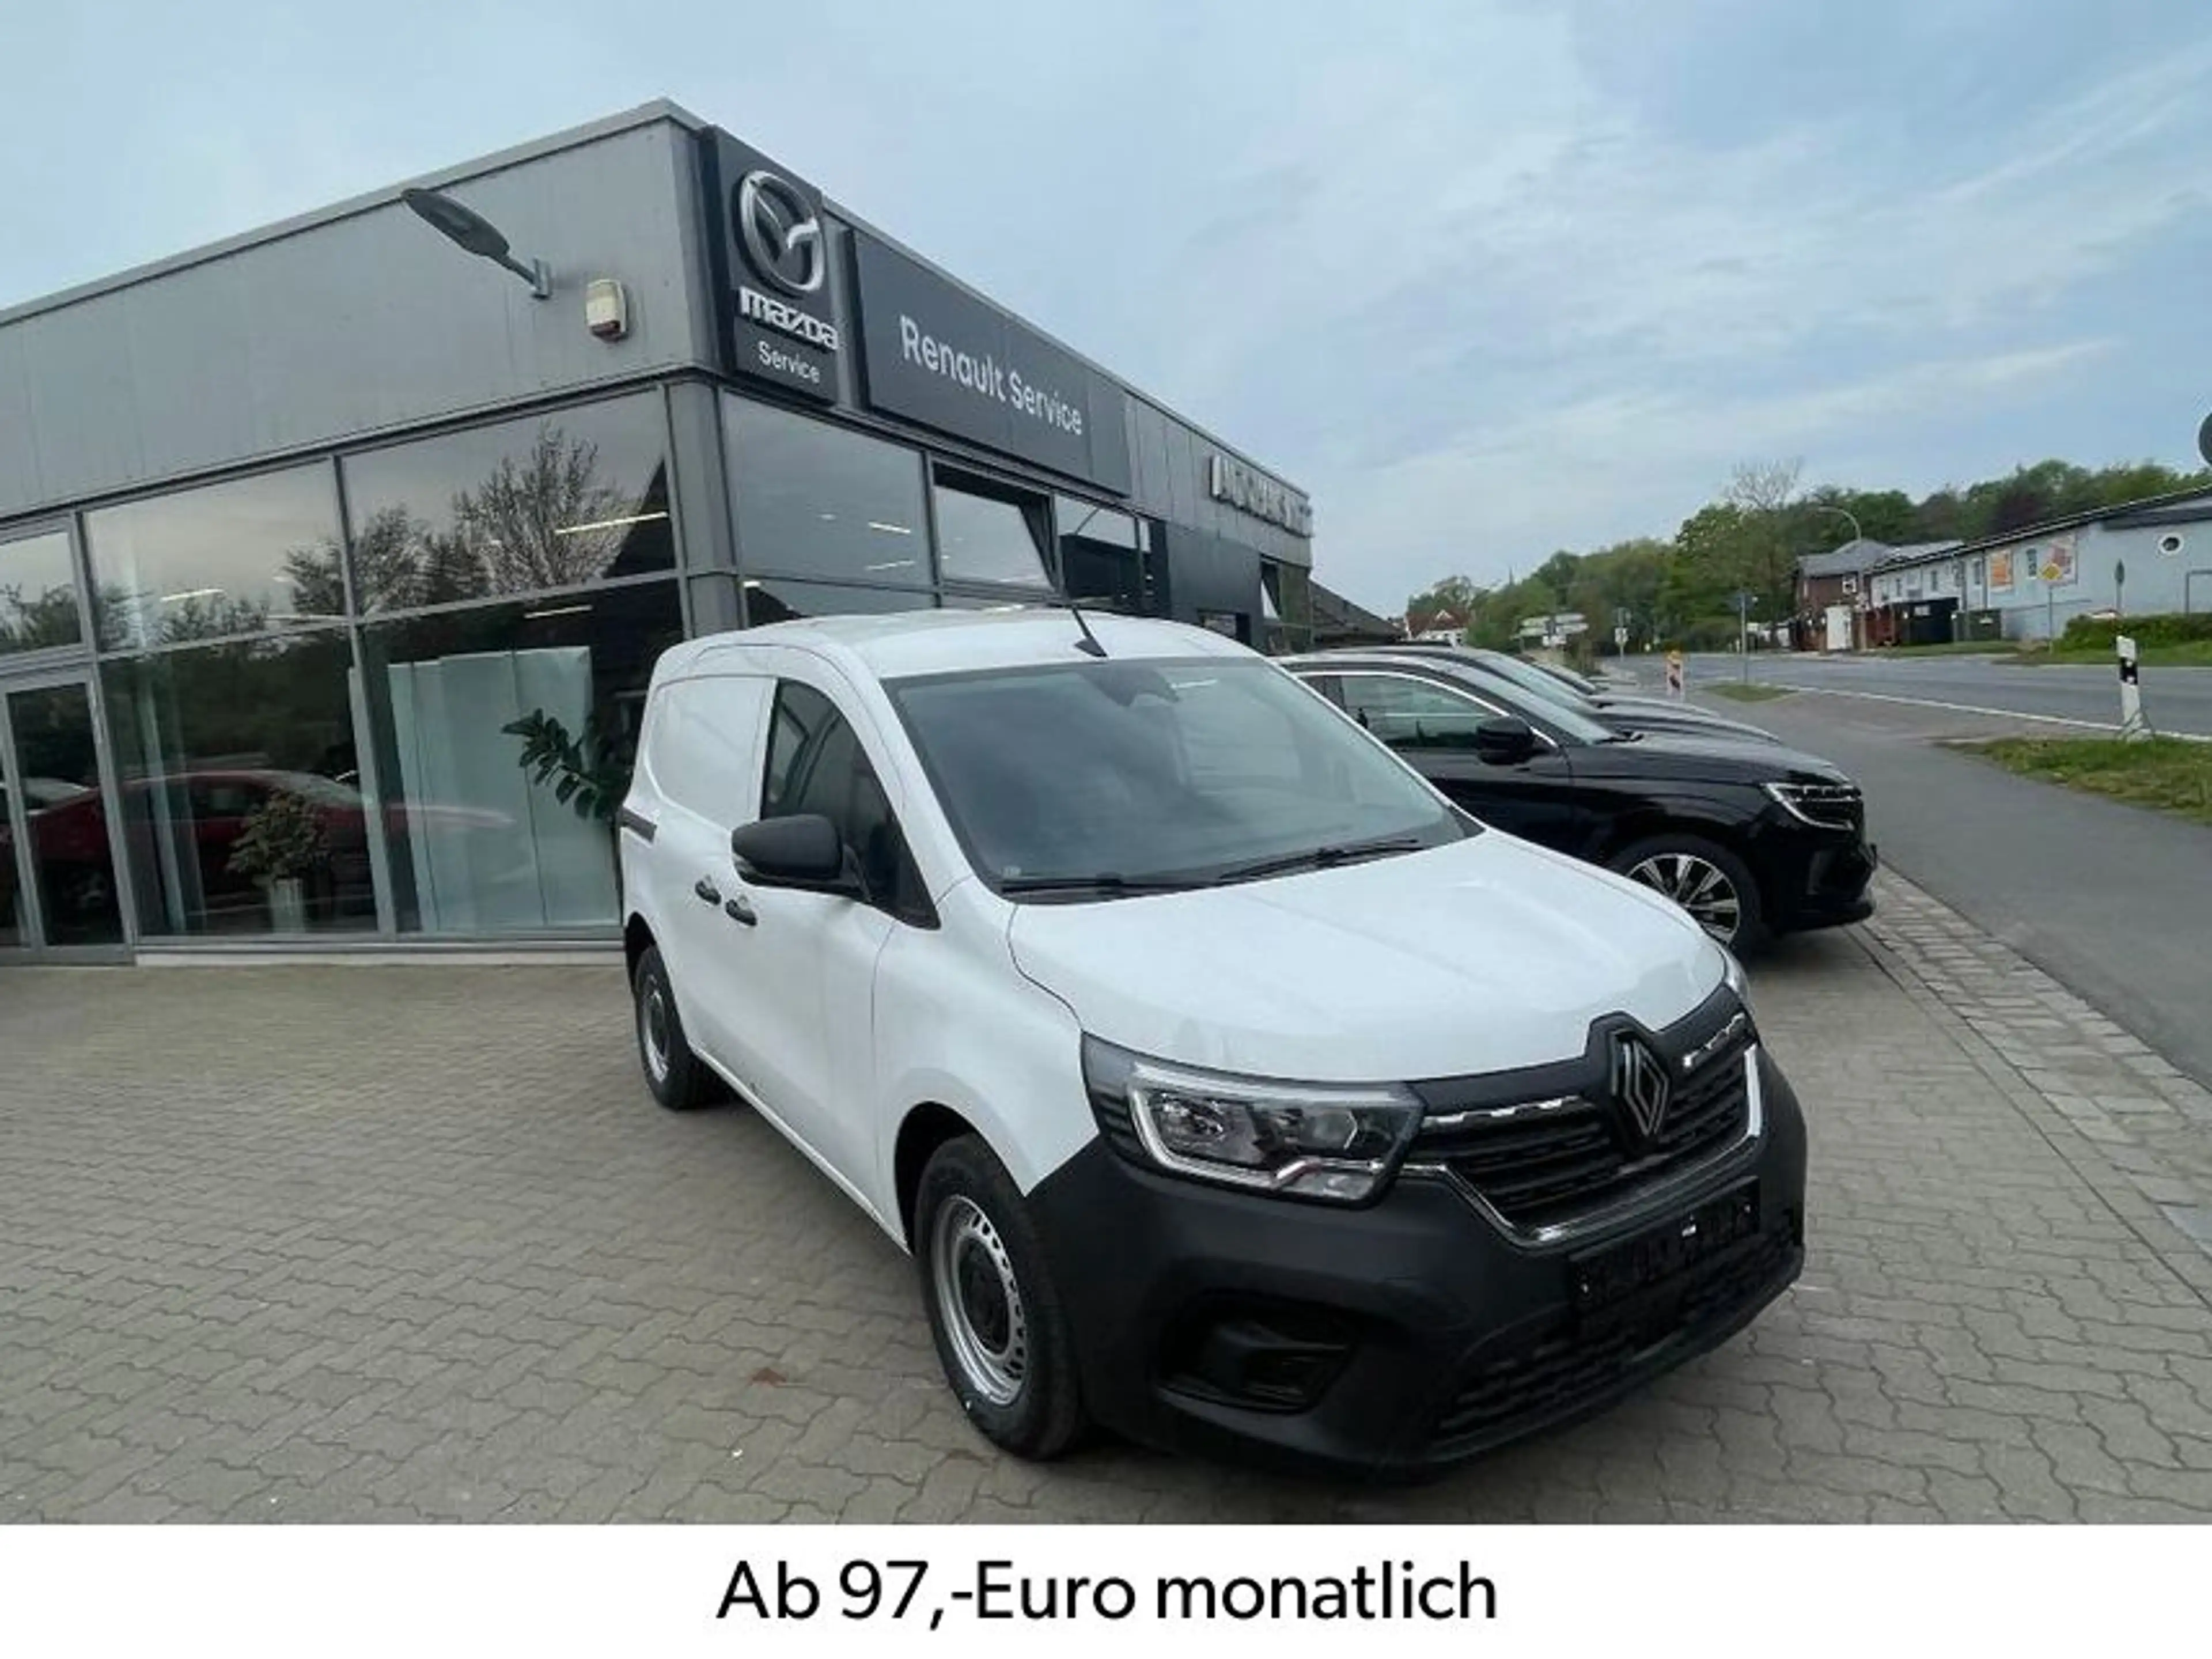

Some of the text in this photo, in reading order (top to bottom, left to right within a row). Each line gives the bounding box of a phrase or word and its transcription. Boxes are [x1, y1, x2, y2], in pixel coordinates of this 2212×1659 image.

[740, 286, 838, 350] mazda
[759, 340, 820, 384] Service
[900, 315, 1082, 435] Renault Service
